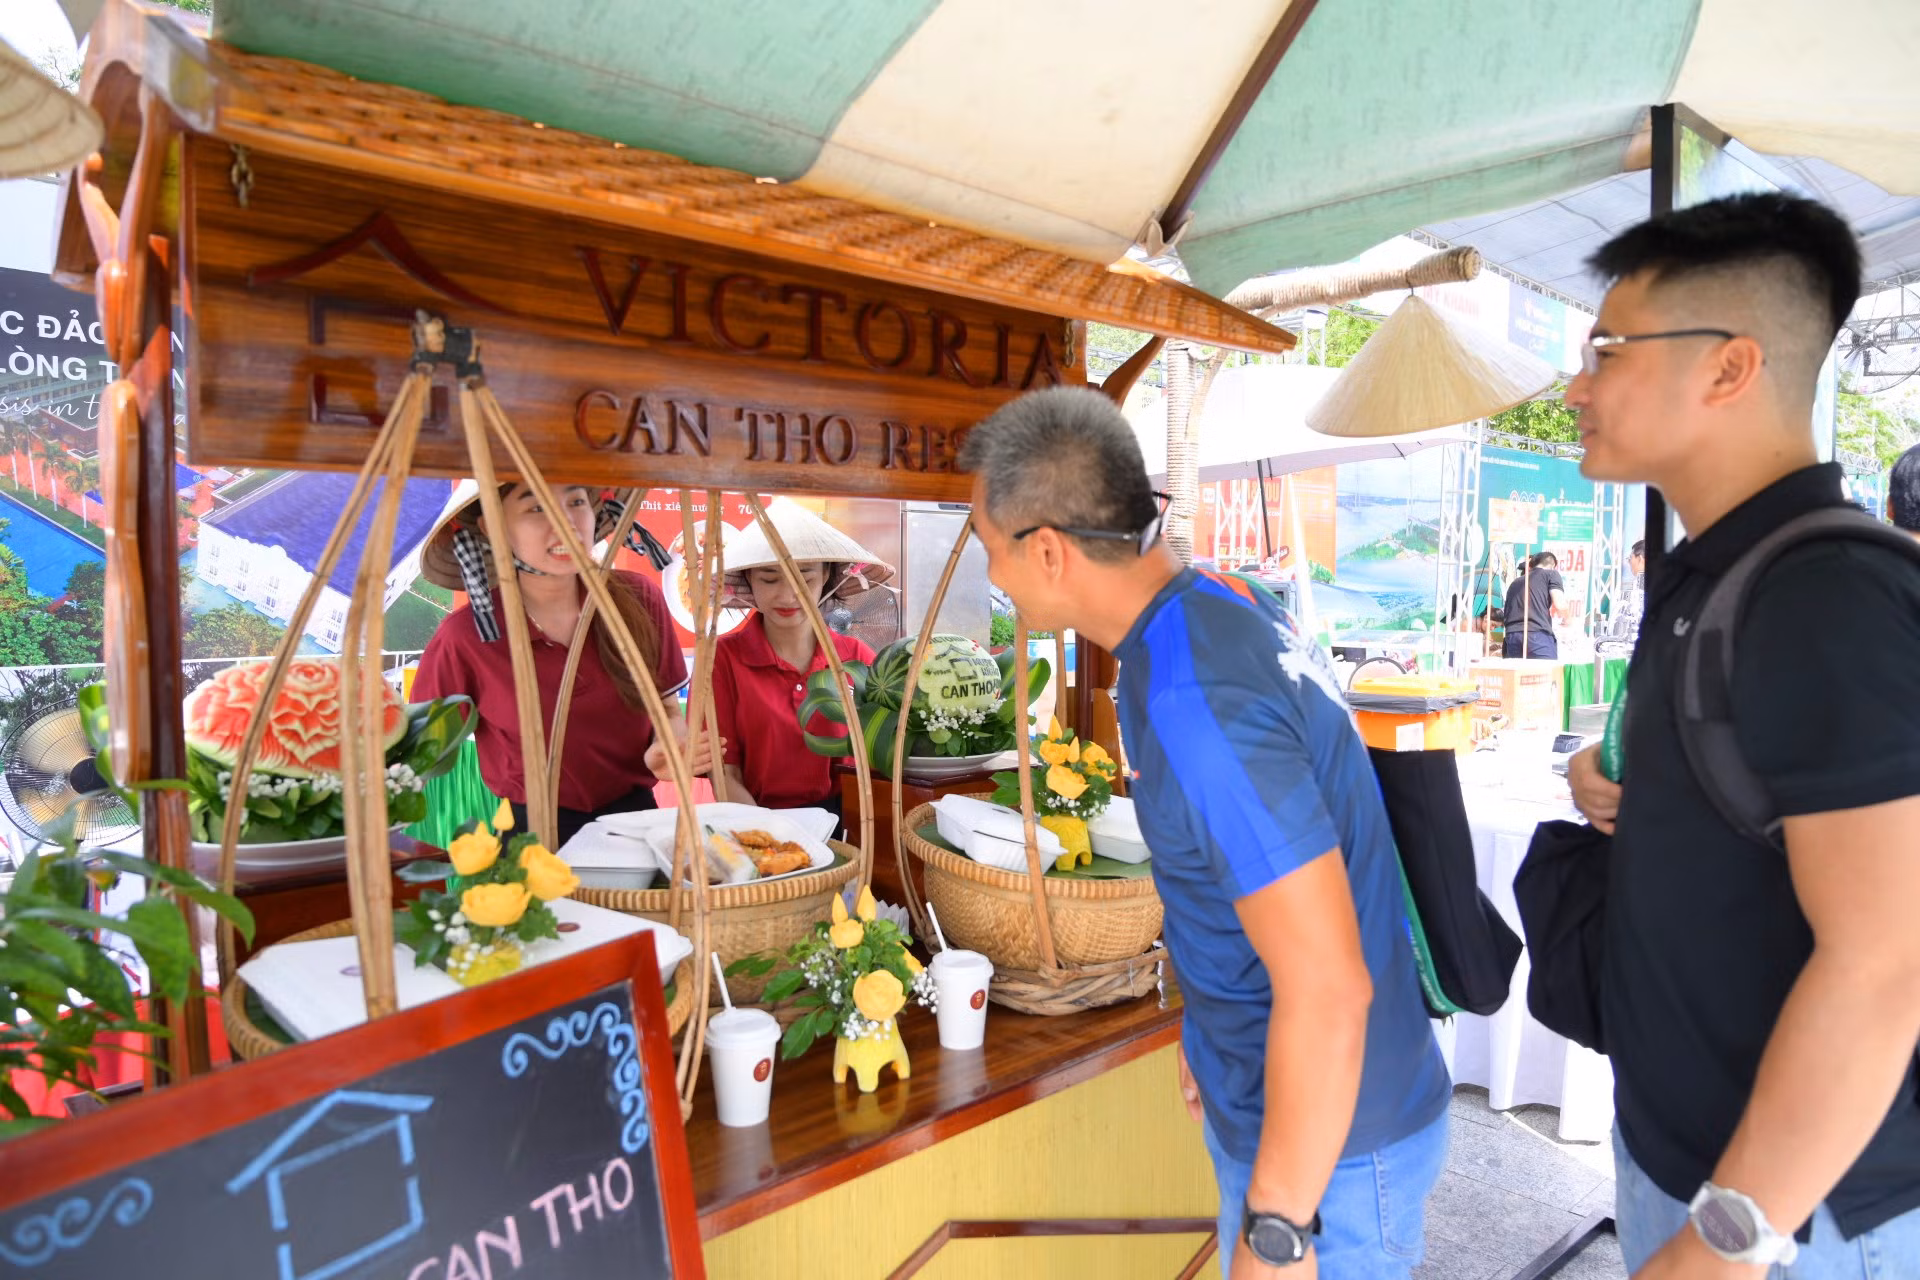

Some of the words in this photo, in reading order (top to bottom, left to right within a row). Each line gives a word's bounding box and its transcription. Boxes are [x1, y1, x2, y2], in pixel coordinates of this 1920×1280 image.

[574, 245, 1062, 391] VICTORIA
[0, 344, 88, 381] ÒNG
[574, 389, 714, 457] CAN
[733, 406, 859, 466] THO
[880, 420, 973, 475] RES
[941, 684, 969, 700] CAN
[970, 681, 993, 697] THO
[529, 1156, 634, 1250] THO
